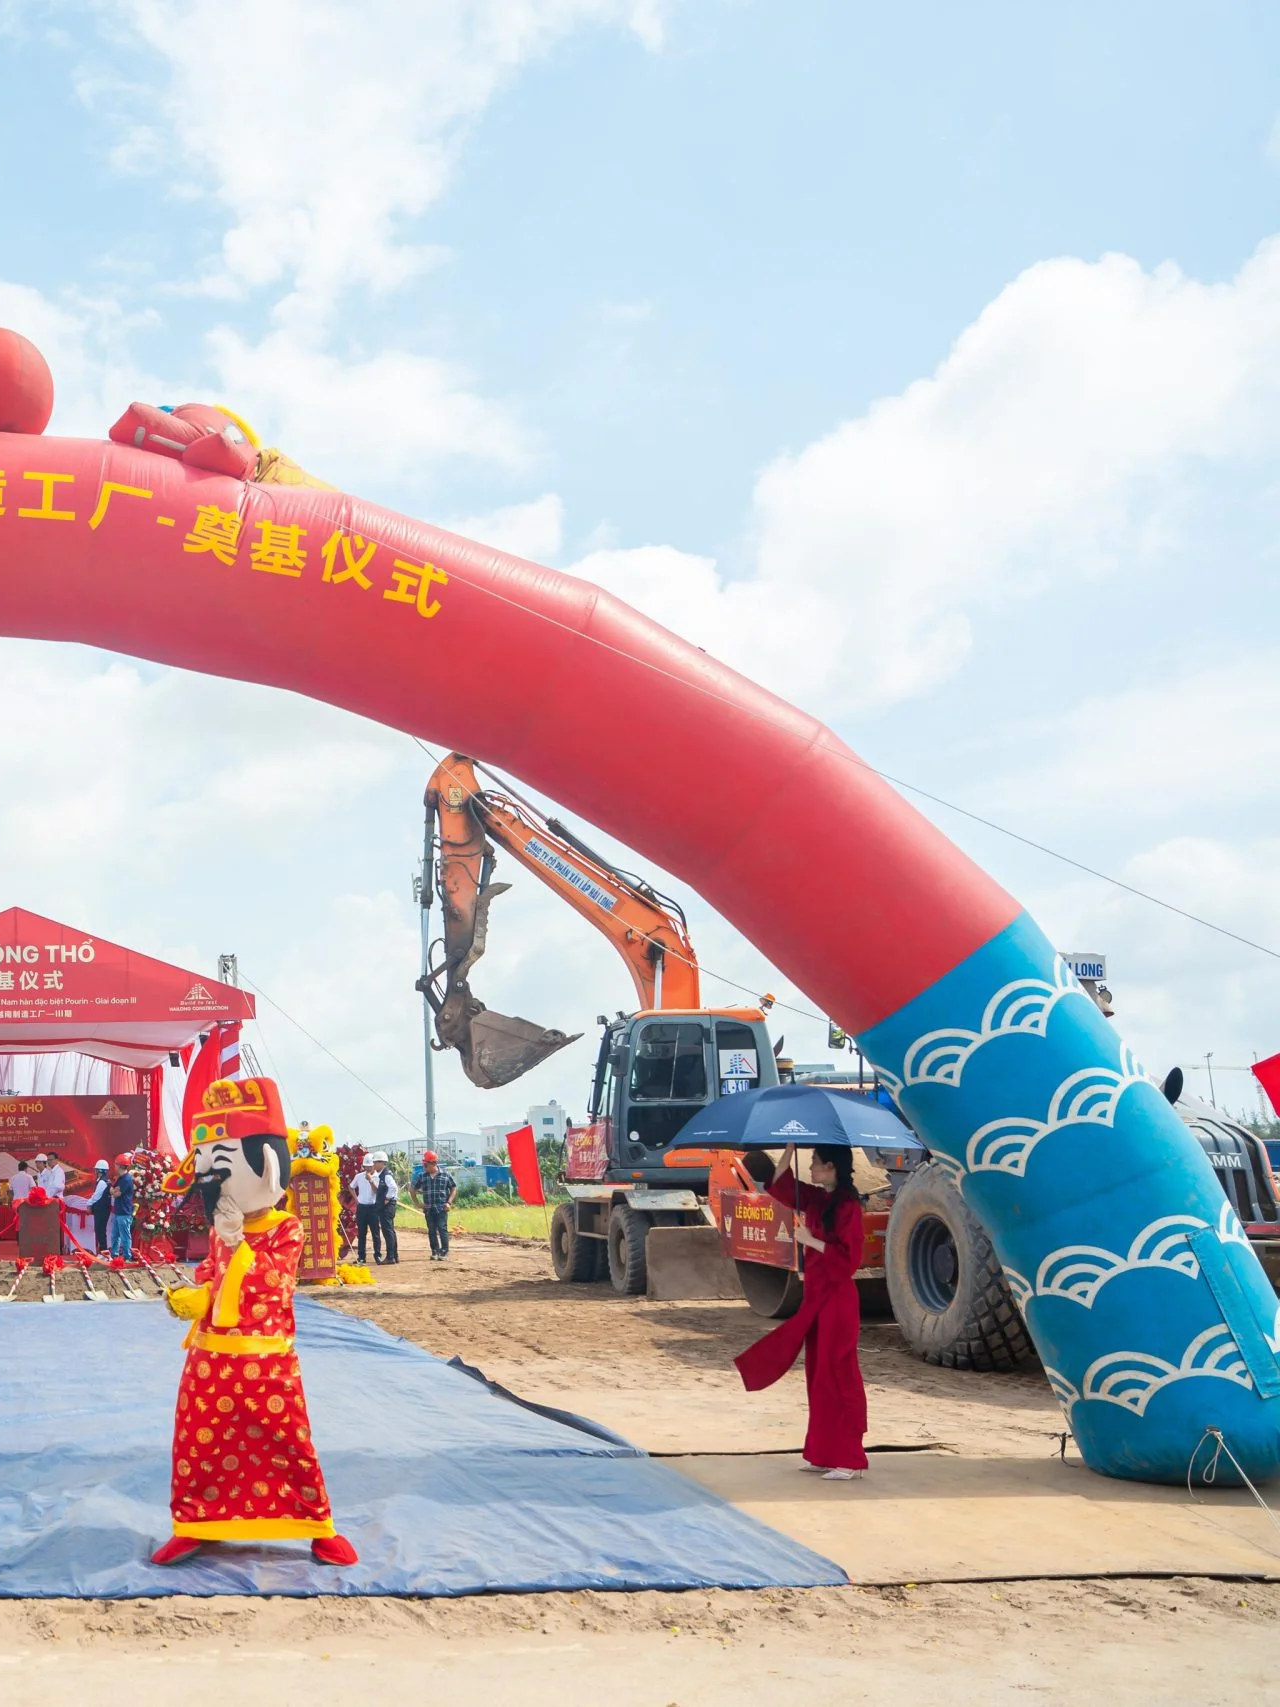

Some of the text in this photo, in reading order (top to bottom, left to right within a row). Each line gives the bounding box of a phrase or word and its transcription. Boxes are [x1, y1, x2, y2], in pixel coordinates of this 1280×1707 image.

[44, 938, 95, 963] THỔ
[1075, 962, 1104, 977] LONG
[0, 998, 18, 1006] Nam
[95, 996, 110, 1004] Giai
[1212, 1154, 1242, 1168] MM
